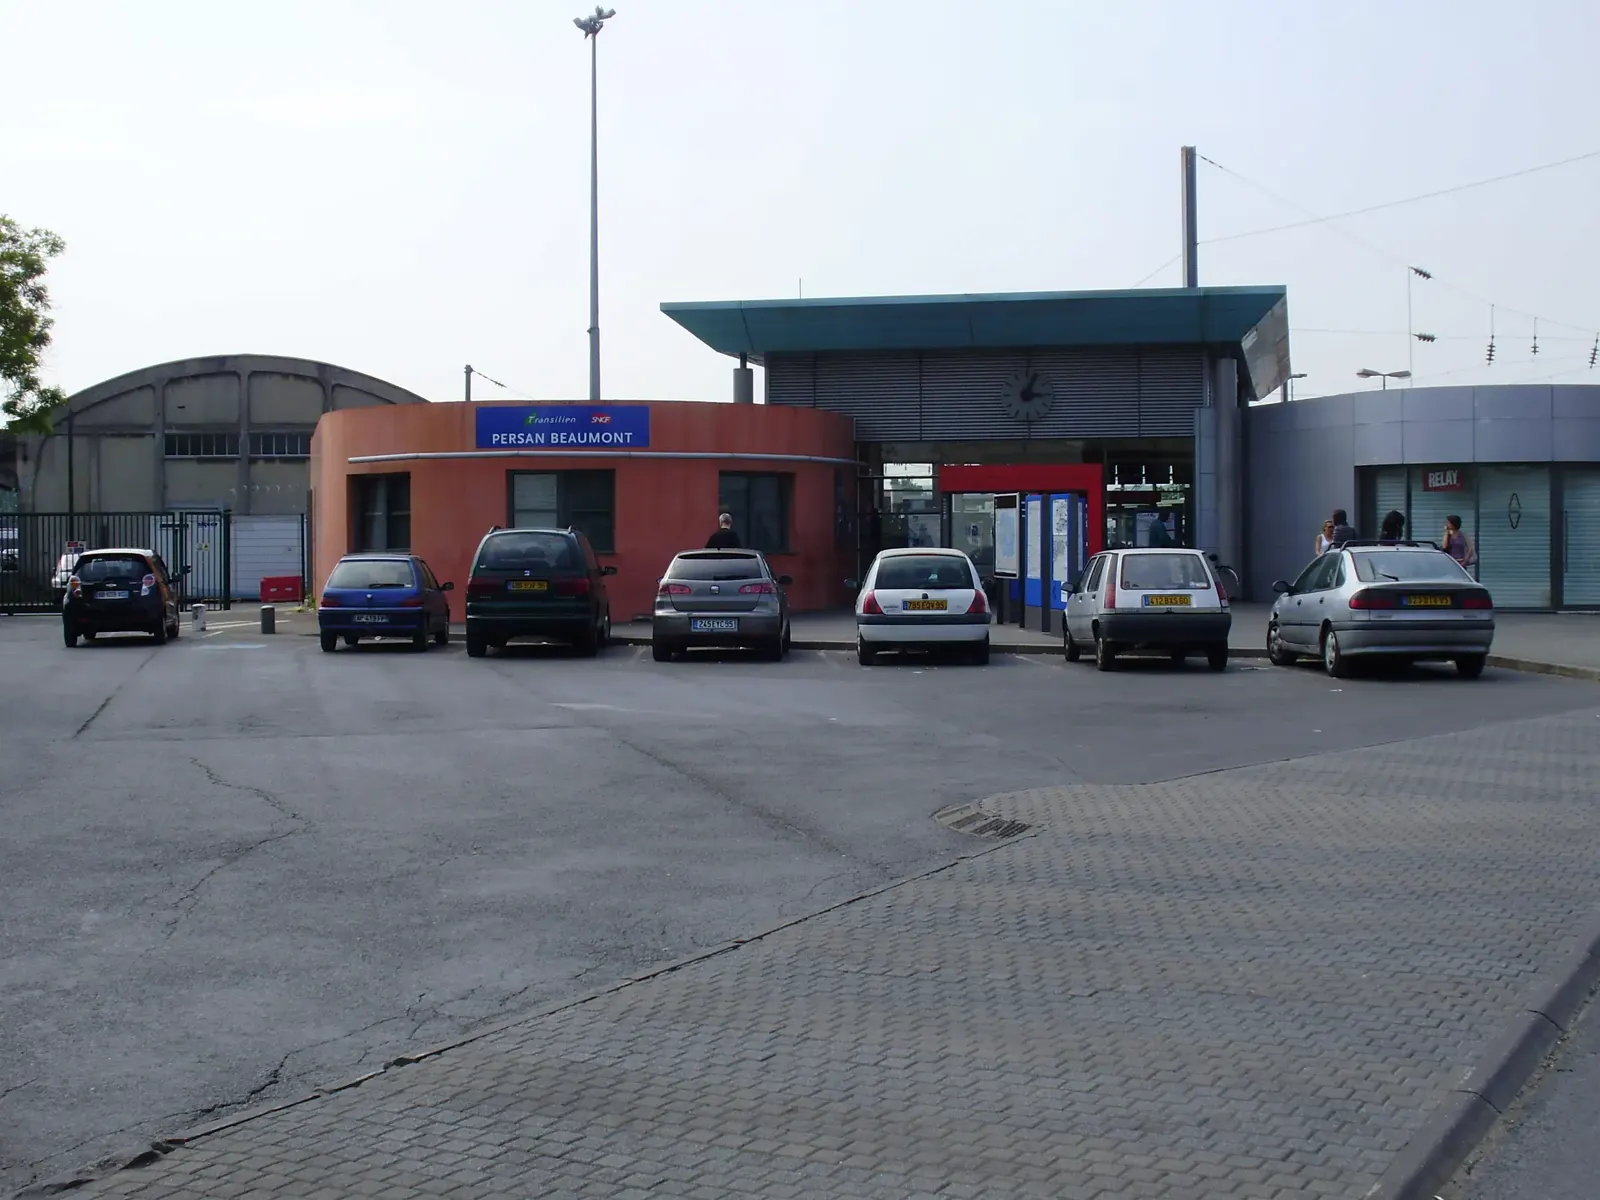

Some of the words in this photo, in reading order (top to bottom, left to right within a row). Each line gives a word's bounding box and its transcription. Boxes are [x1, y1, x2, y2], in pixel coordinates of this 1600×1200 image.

[528, 415, 576, 424] Transilien
[591, 416, 611, 424] SNCF
[492, 433, 545, 444] PERSAN
[551, 432, 632, 444] BEAUMONT
